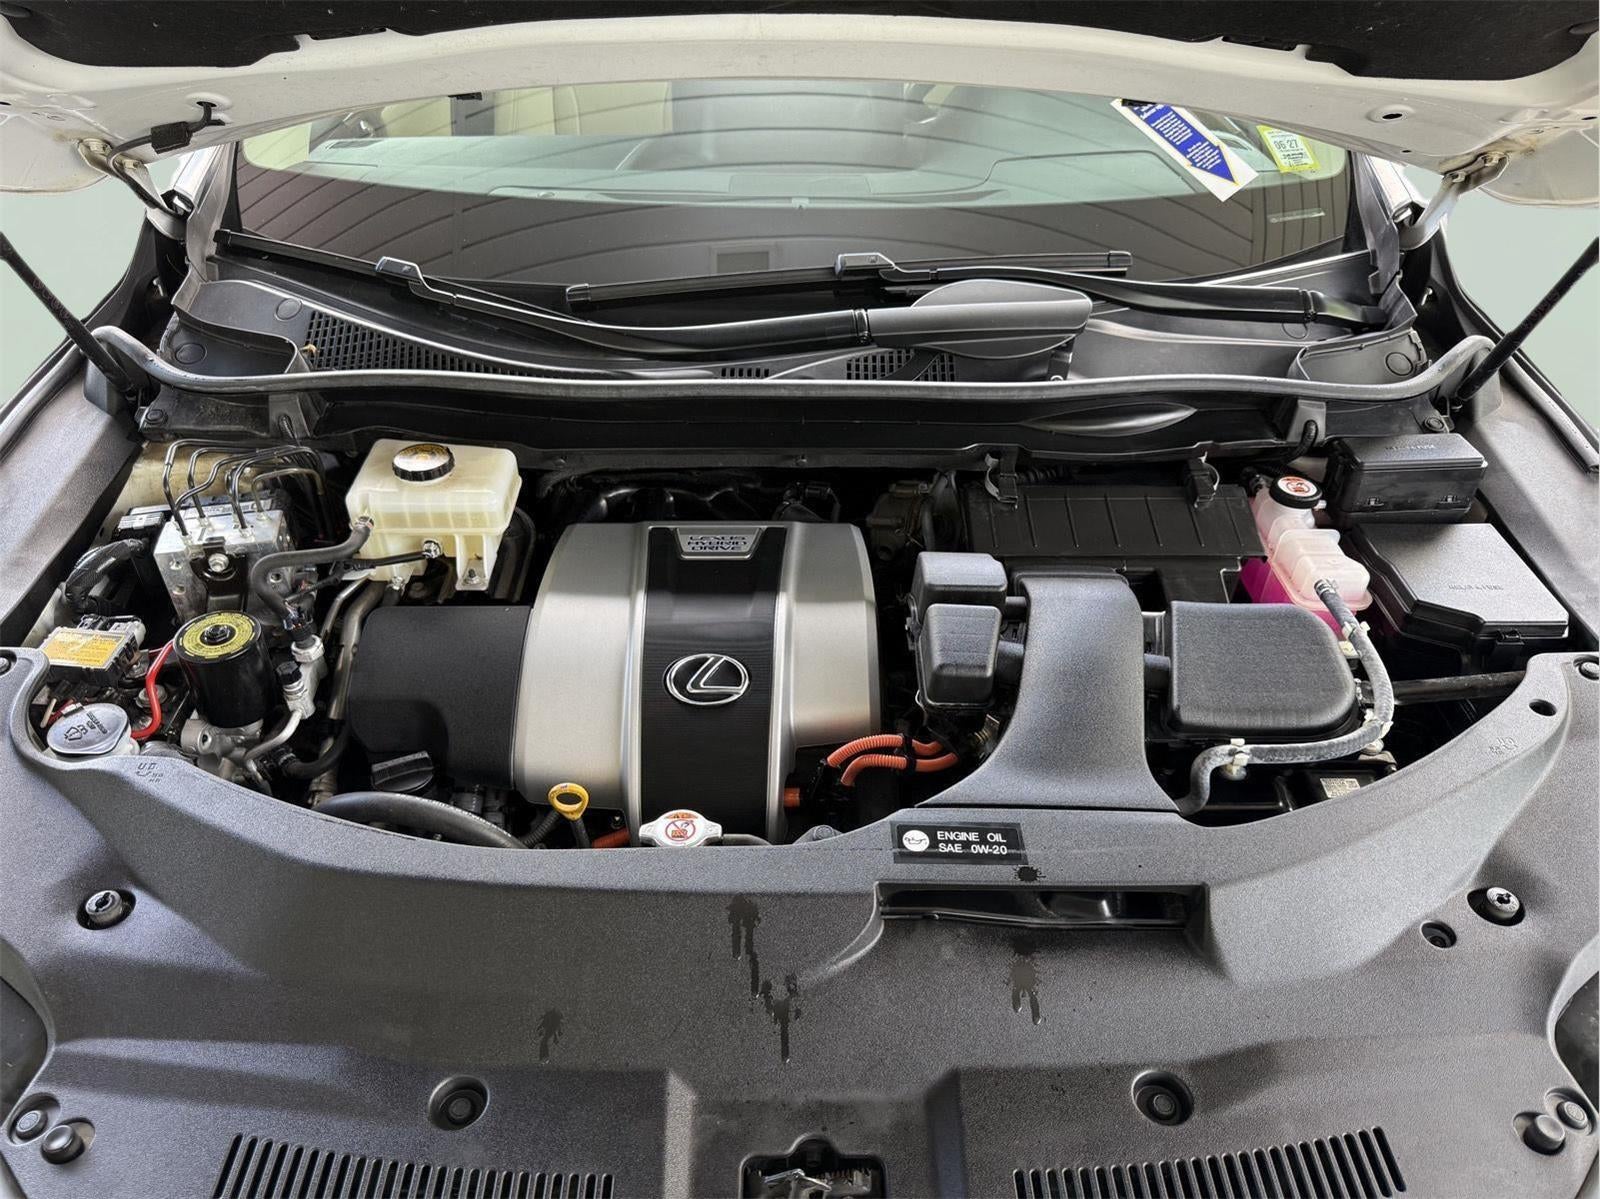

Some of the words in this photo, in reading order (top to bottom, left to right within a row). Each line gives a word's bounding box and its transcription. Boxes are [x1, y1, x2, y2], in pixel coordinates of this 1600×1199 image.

[936, 831, 980, 842] ENGINE
[986, 832, 1007, 843] OIL
[938, 843, 963, 854] SAE
[970, 844, 1008, 855] 0W-20
